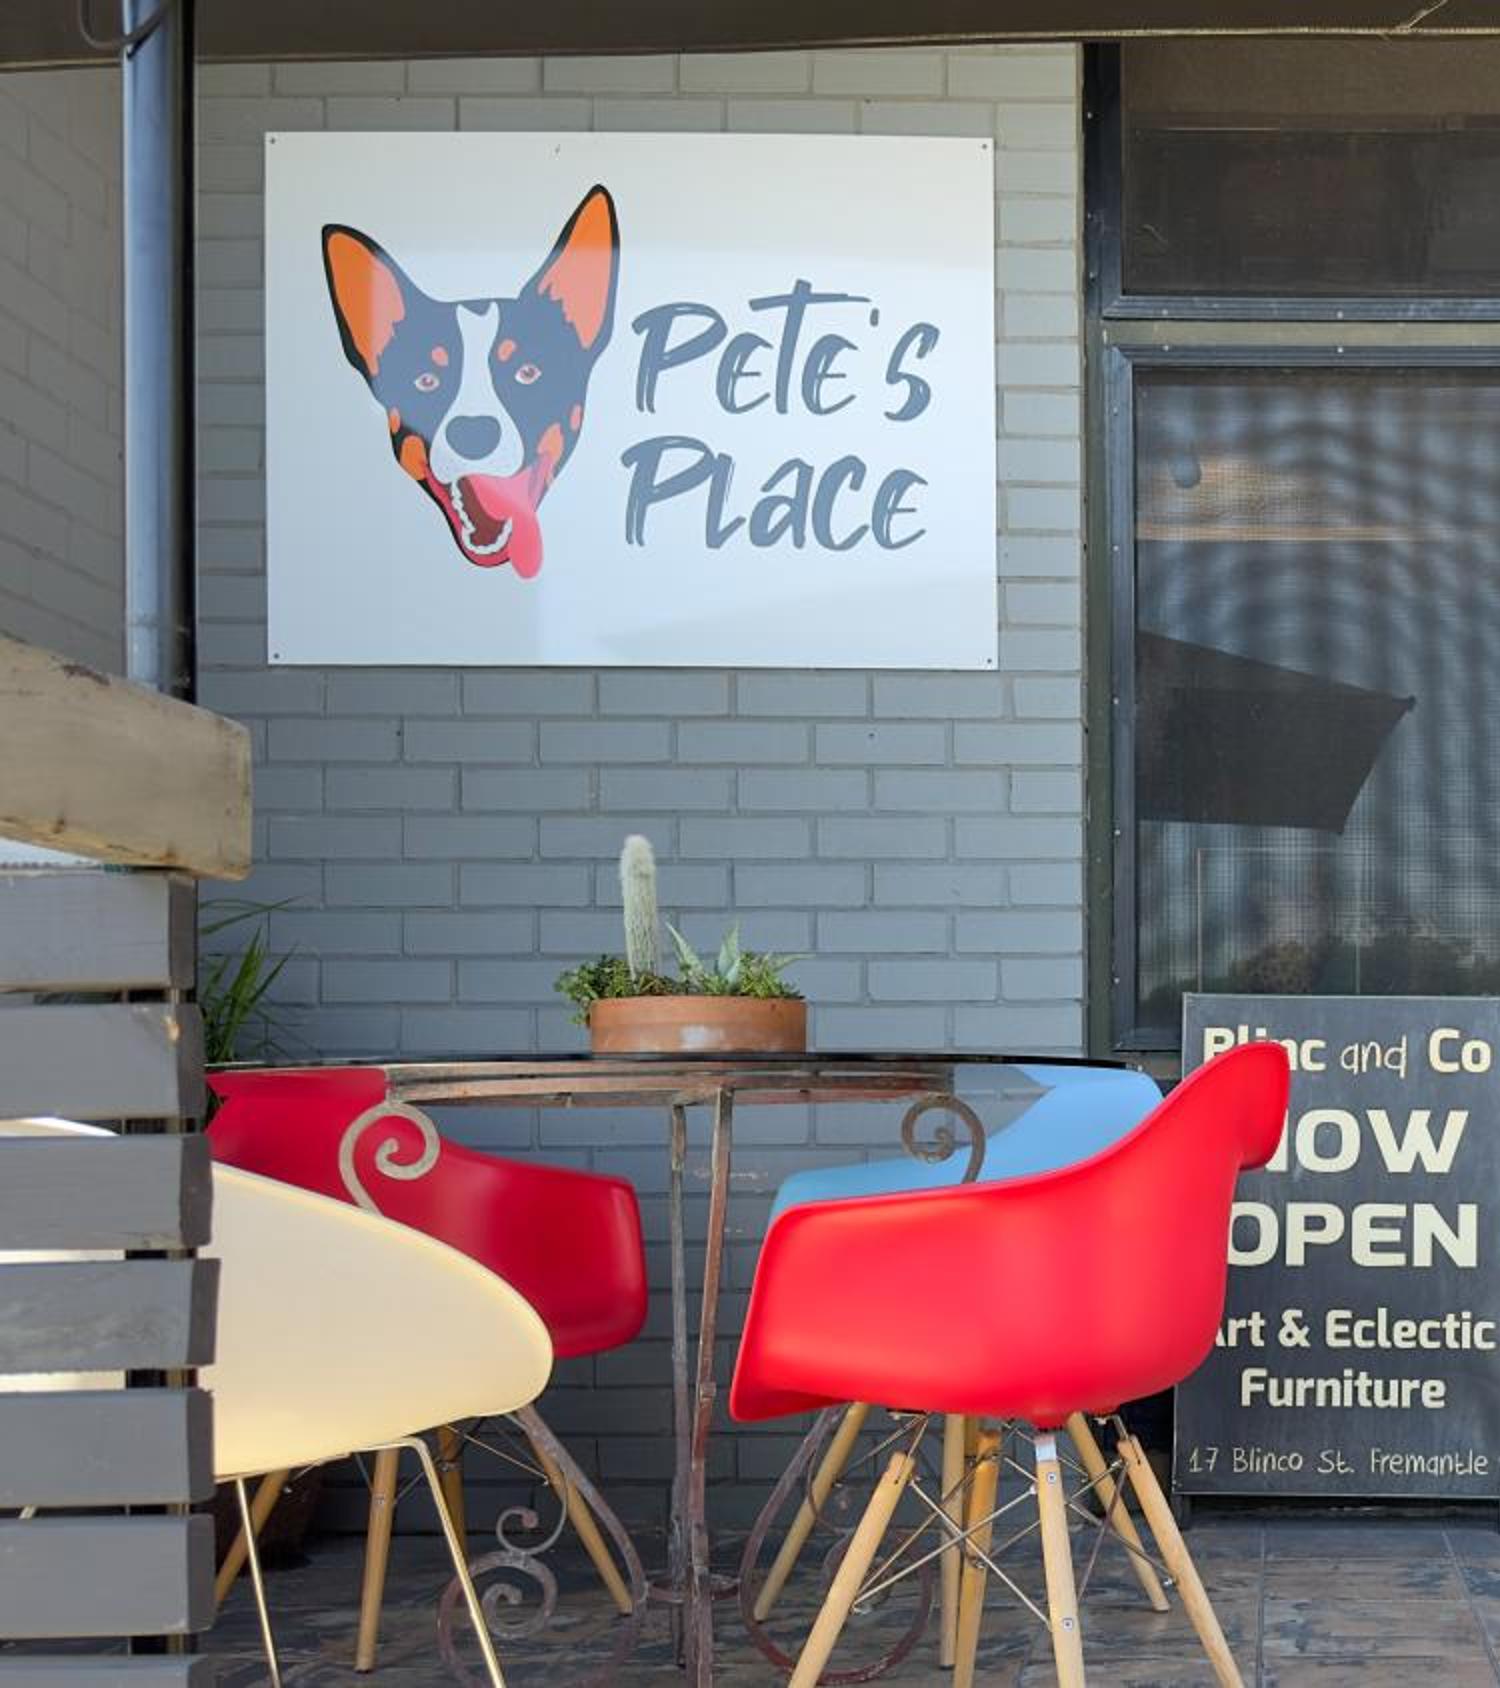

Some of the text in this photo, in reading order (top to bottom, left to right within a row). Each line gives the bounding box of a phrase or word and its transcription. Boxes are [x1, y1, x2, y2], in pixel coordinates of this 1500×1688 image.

[1203, 1025, 1492, 1079] Bnc and Co
[1264, 1109, 1469, 1173] OW
[1226, 1201, 1478, 1268] OPEN
[1278, 1309, 1311, 1347] &
[1325, 1308, 1497, 1350] Eclectic
[1240, 1367, 1446, 1409] Furniture
[1188, 1447, 1219, 1473] 17
[1232, 1447, 1303, 1473] Blinco
[1371, 1447, 1489, 1477] Fremantle
